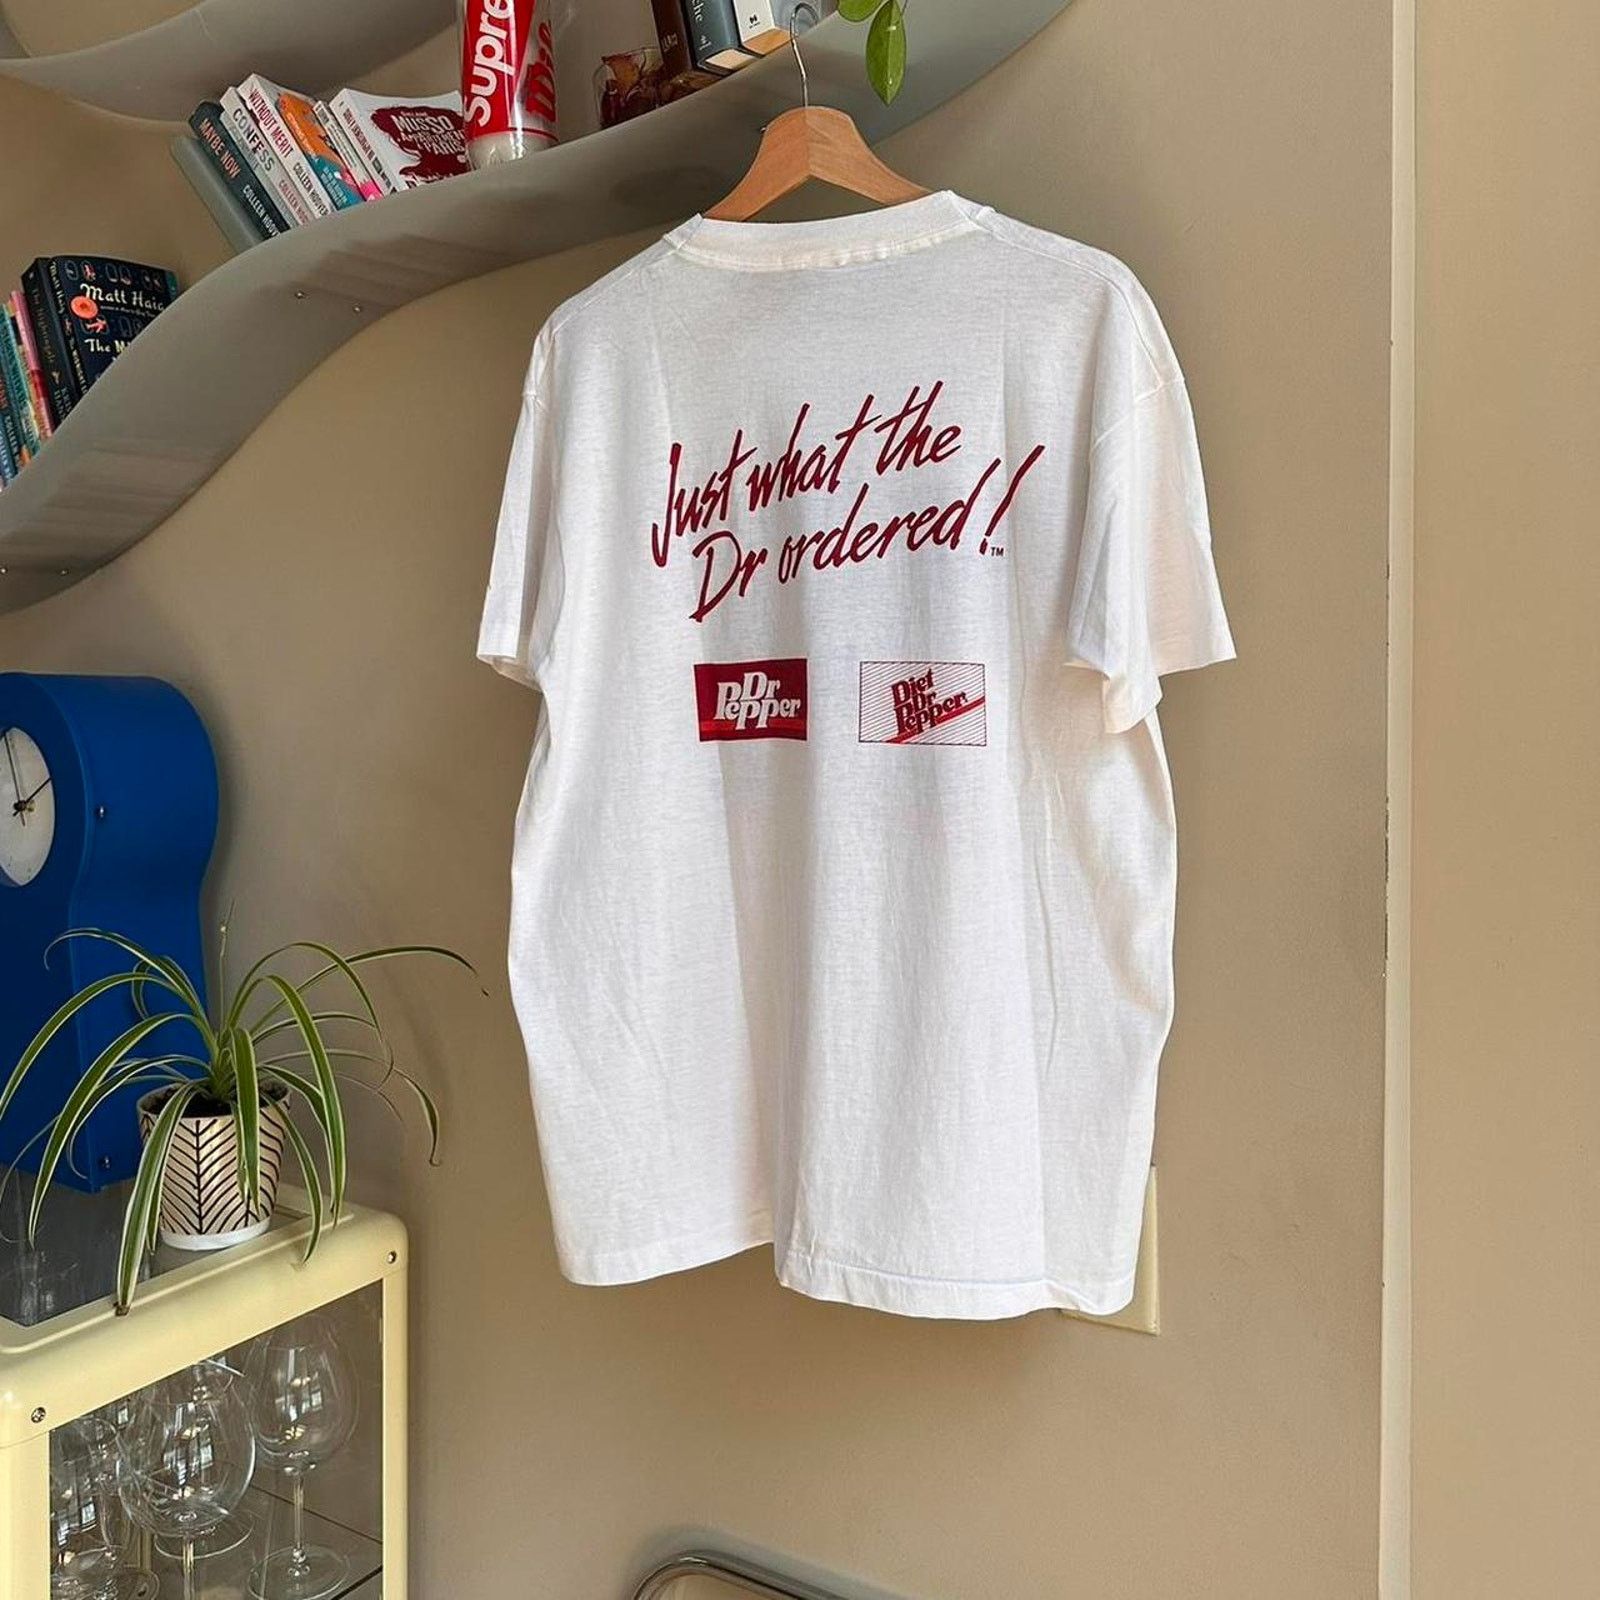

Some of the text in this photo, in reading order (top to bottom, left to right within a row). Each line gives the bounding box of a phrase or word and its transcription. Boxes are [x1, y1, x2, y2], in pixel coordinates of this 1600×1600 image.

[232, 107, 276, 172] CONFESS
[249, 88, 294, 159] WITHOUT MERIT
[390, 114, 455, 134] MUSSO
[199, 117, 242, 180] MAYBE NOW
[278, 178, 302, 215] COLLEEN
[293, 161, 315, 194] COLLEEN
[242, 183, 264, 219] COLLEEN
[80, 283, 128, 304] Matt
[84, 338, 112, 353] The
[652, 380, 962, 568] Just what the
[689, 530, 768, 623] Dr
[741, 671, 781, 700] Dr
[891, 668, 934, 707] Diet
[912, 691, 937, 711] Dr
[714, 681, 802, 730] Pepper
[894, 691, 969, 735] Pepper
